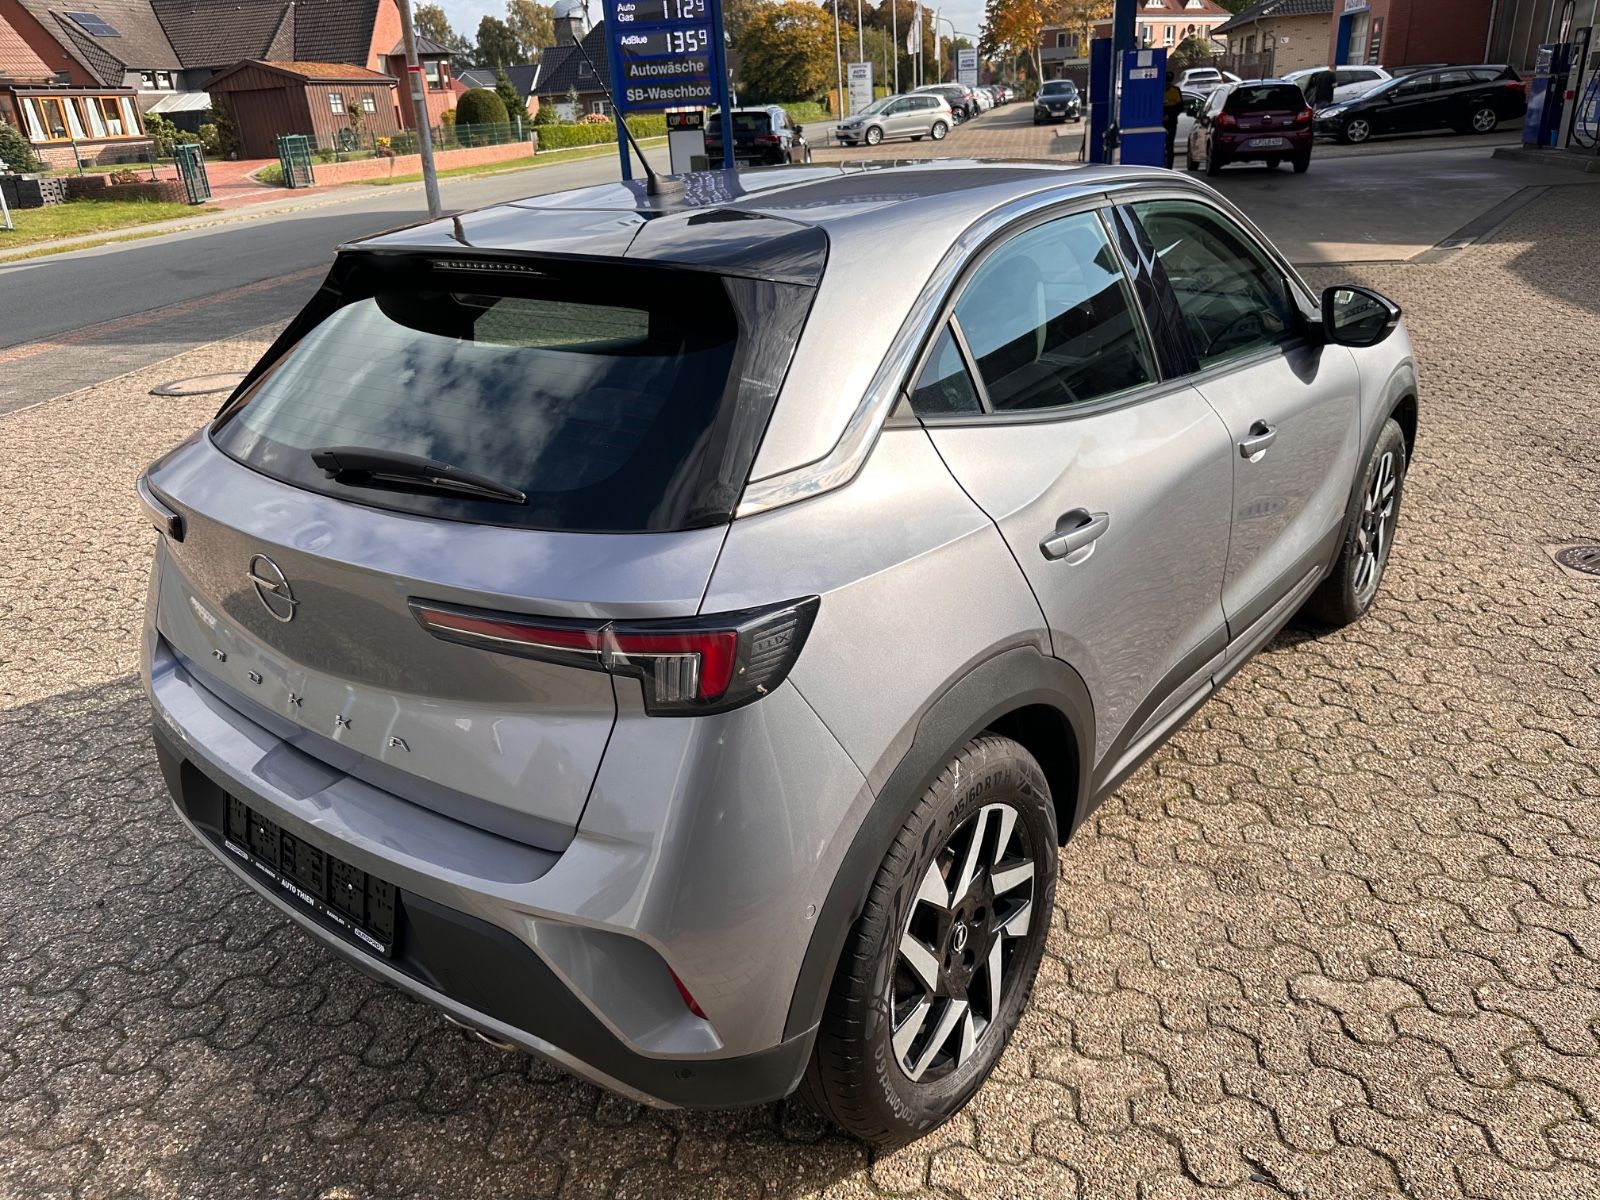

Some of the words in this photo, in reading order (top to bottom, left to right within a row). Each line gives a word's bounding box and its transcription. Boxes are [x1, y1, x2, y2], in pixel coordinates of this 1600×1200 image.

[617, 3, 636, 12] Auto
[618, 13, 635, 22] Gas
[621, 35, 648, 46] AdBlue
[630, 60, 705, 77] Autowäsche
[626, 85, 712, 102] SB-Waschbox
[948, 782, 983, 826] 215/60
[985, 775, 992, 791] R
[281, 878, 297, 894] AUTO
[297, 888, 315, 906] THIEN
